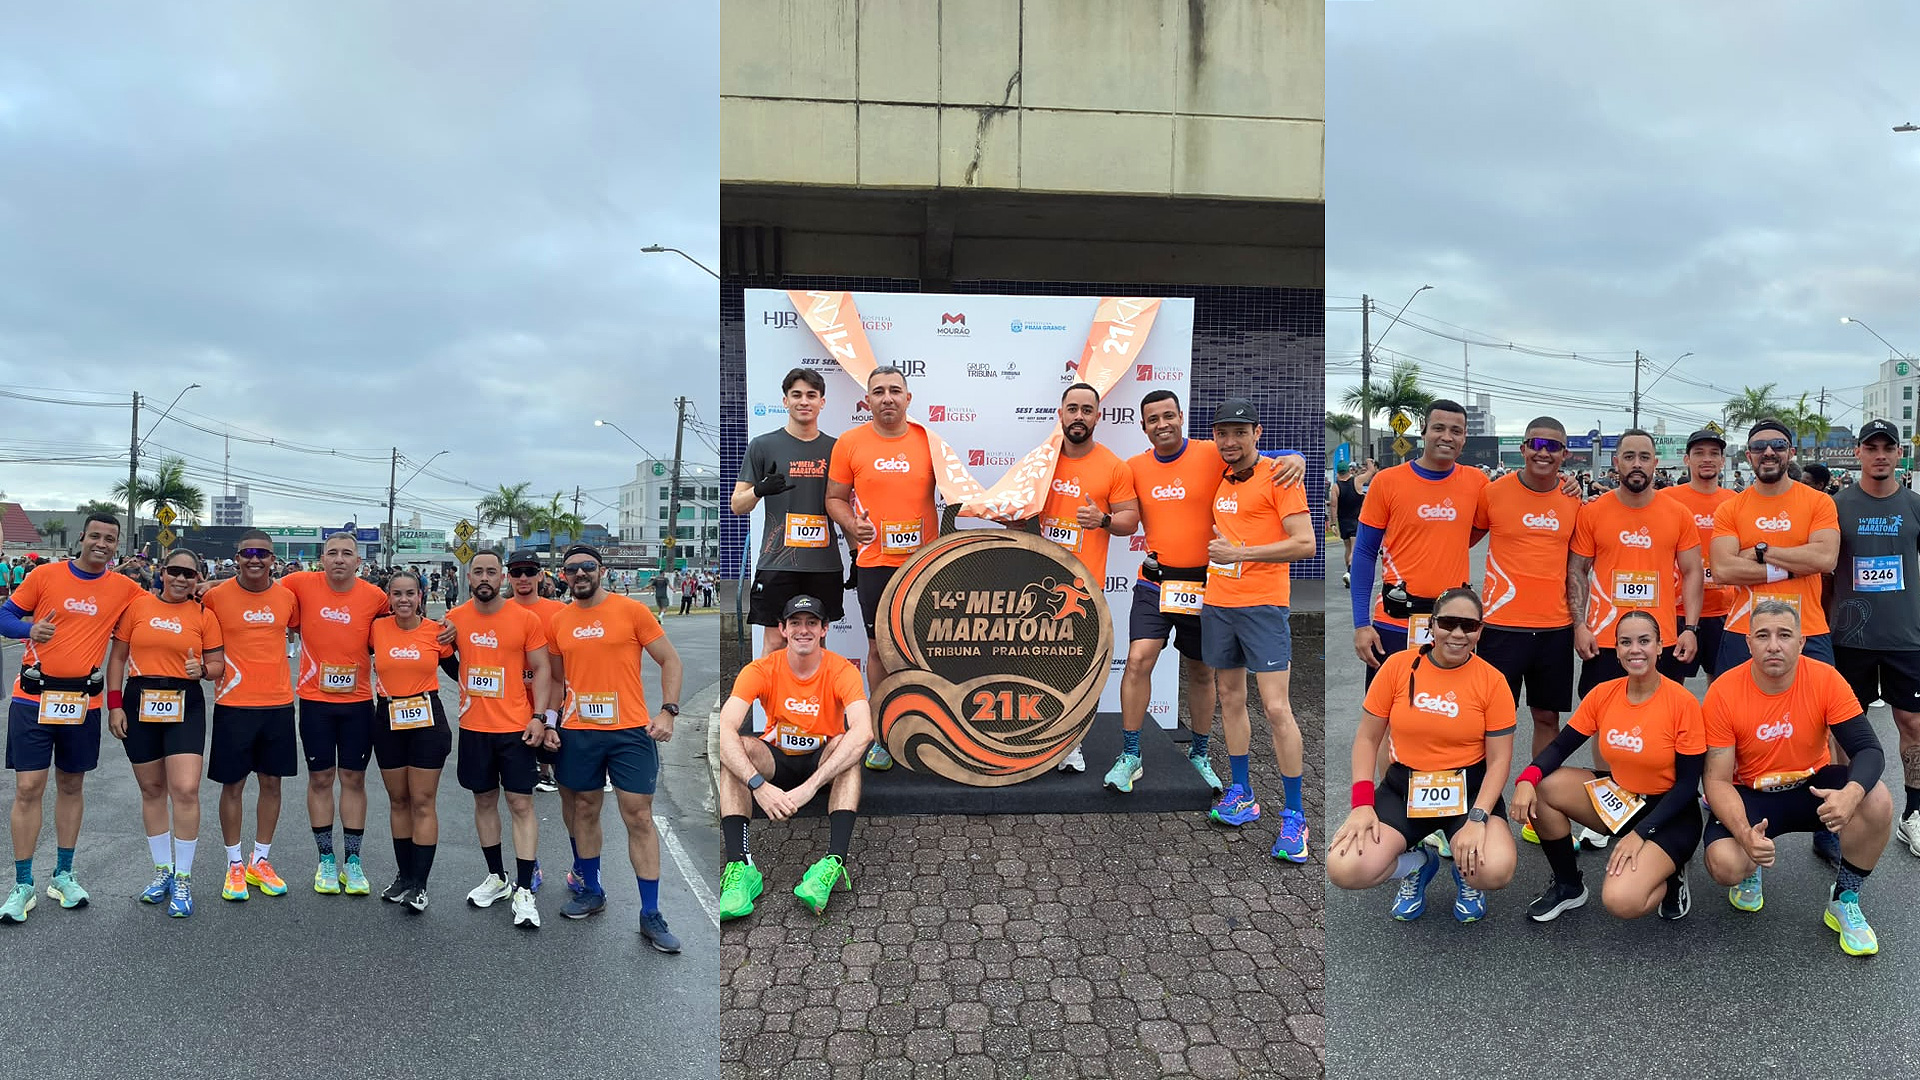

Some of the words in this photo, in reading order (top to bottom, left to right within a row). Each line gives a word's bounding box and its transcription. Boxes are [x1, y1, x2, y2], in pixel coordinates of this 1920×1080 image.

[763, 311, 799, 329] HJR
[862, 321, 893, 331] IGESP
[937, 326, 971, 335] MOURÃO
[967, 370, 998, 378] TRIBUNA
[1153, 371, 1184, 381] IGESP
[946, 411, 977, 422] IGESP
[1102, 407, 1135, 425] HJR
[874, 457, 910, 473] Gelog
[985, 457, 1016, 466] IGESP
[1051, 478, 1081, 498] Gelog
[1152, 484, 1186, 500] Gelog
[1417, 503, 1456, 521] Gelog
[1522, 513, 1560, 531] Gelog
[1755, 516, 1792, 532] Gelog
[1857, 524, 1899, 533] MARATONA
[797, 526, 821, 537] 1077
[890, 533, 918, 544] 1096
[1049, 526, 1072, 540] 1891
[1619, 529, 1652, 549] Gelog
[1862, 569, 1894, 580] 3246
[1623, 583, 1648, 595] 1891
[965, 591, 1035, 614] MEIA
[1174, 592, 1197, 604] 708
[63, 597, 99, 616] Gelog
[243, 610, 275, 624] Gelog
[320, 606, 351, 624] Gelog
[150, 617, 183, 634] Gelog
[573, 625, 605, 638] Gelog
[926, 617, 1075, 642] MARATONA
[469, 632, 498, 648] Gelog
[389, 646, 421, 660] Gelog
[926, 647, 981, 657] TRIBUNA
[992, 647, 1030, 656] PRAIA
[1032, 646, 1084, 656] GRANDE
[328, 674, 352, 684] 1096
[472, 676, 493, 687] 1891
[53, 703, 76, 714] 708
[151, 701, 173, 712] 700
[589, 704, 604, 714] 1111
[784, 696, 820, 717] Gelog
[1414, 692, 1459, 718] Gelog
[401, 708, 422, 719] 1159
[786, 734, 815, 747] 1889
[1606, 728, 1644, 753] Gelog
[1421, 787, 1451, 802] 700
[1601, 791, 1623, 812] 1159
